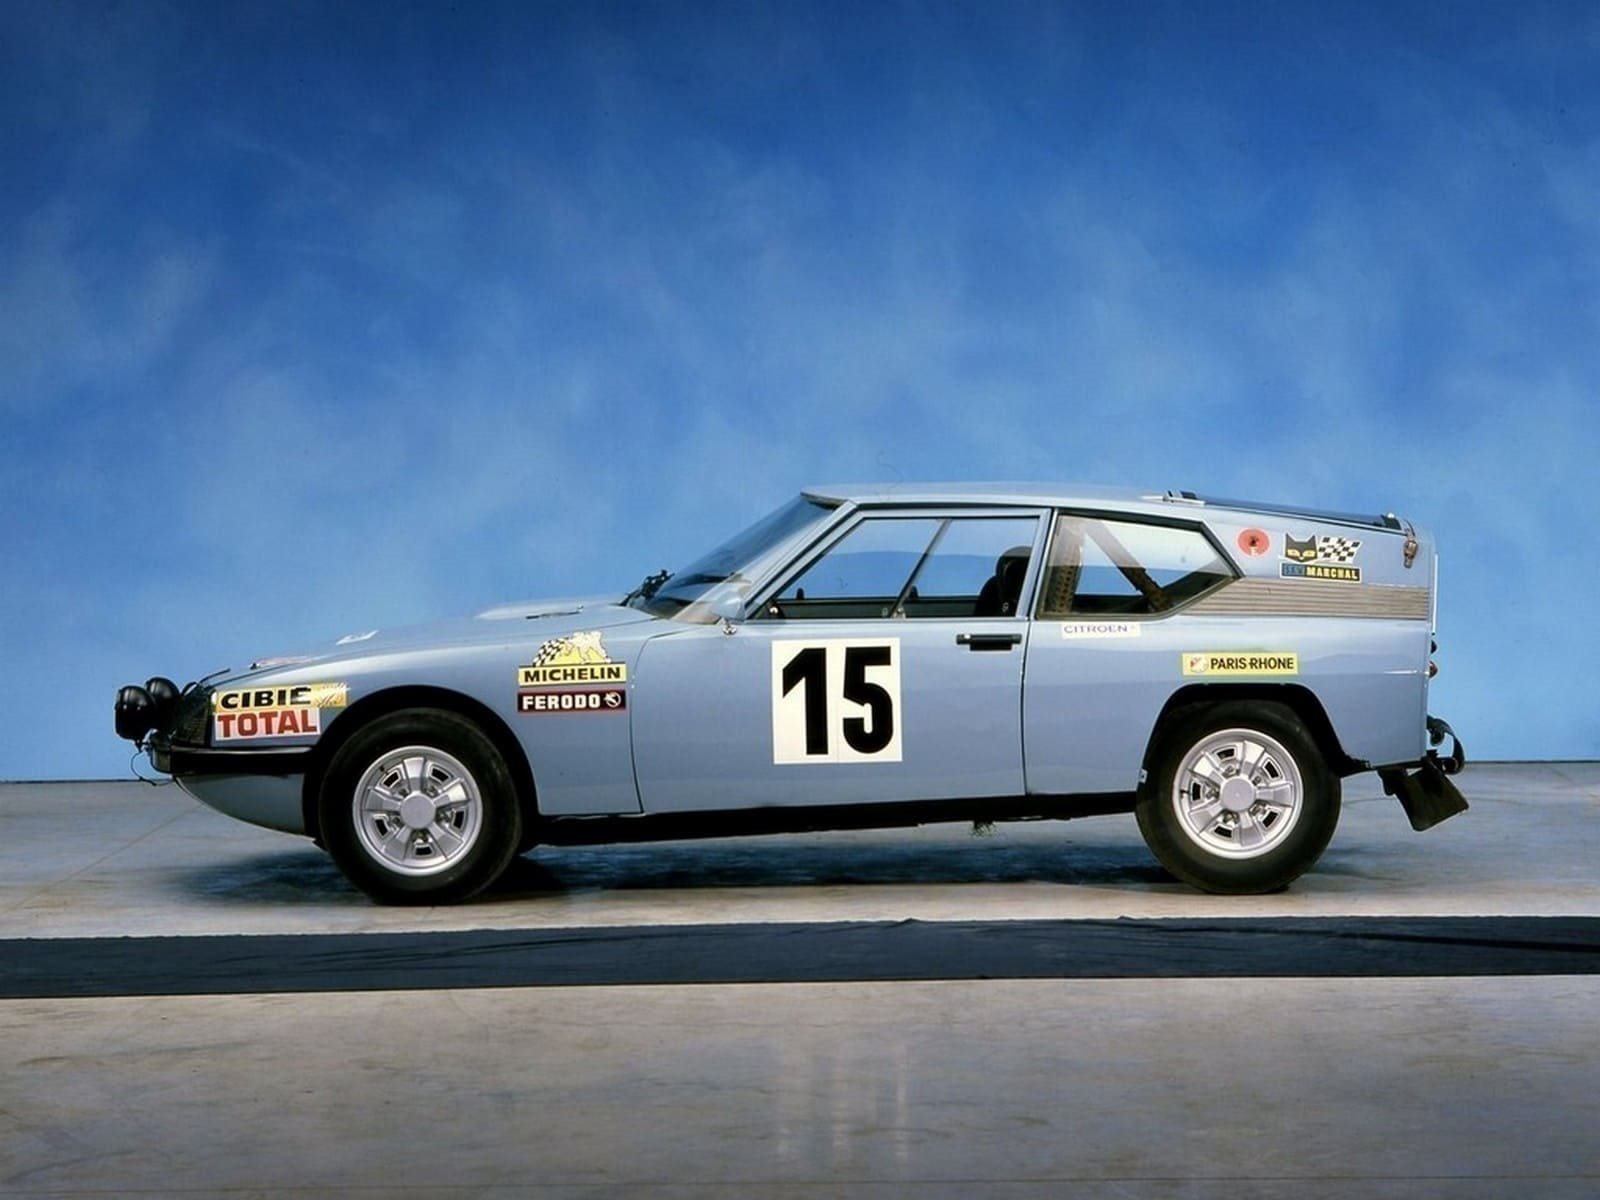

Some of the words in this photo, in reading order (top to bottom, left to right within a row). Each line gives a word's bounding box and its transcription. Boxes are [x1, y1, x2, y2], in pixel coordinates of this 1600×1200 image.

[1306, 566, 1358, 579] MARCHAL
[524, 667, 620, 682] MICHELIN
[522, 694, 600, 710] FERODO
[782, 646, 893, 755] 15
[217, 710, 317, 738] TOTAL
